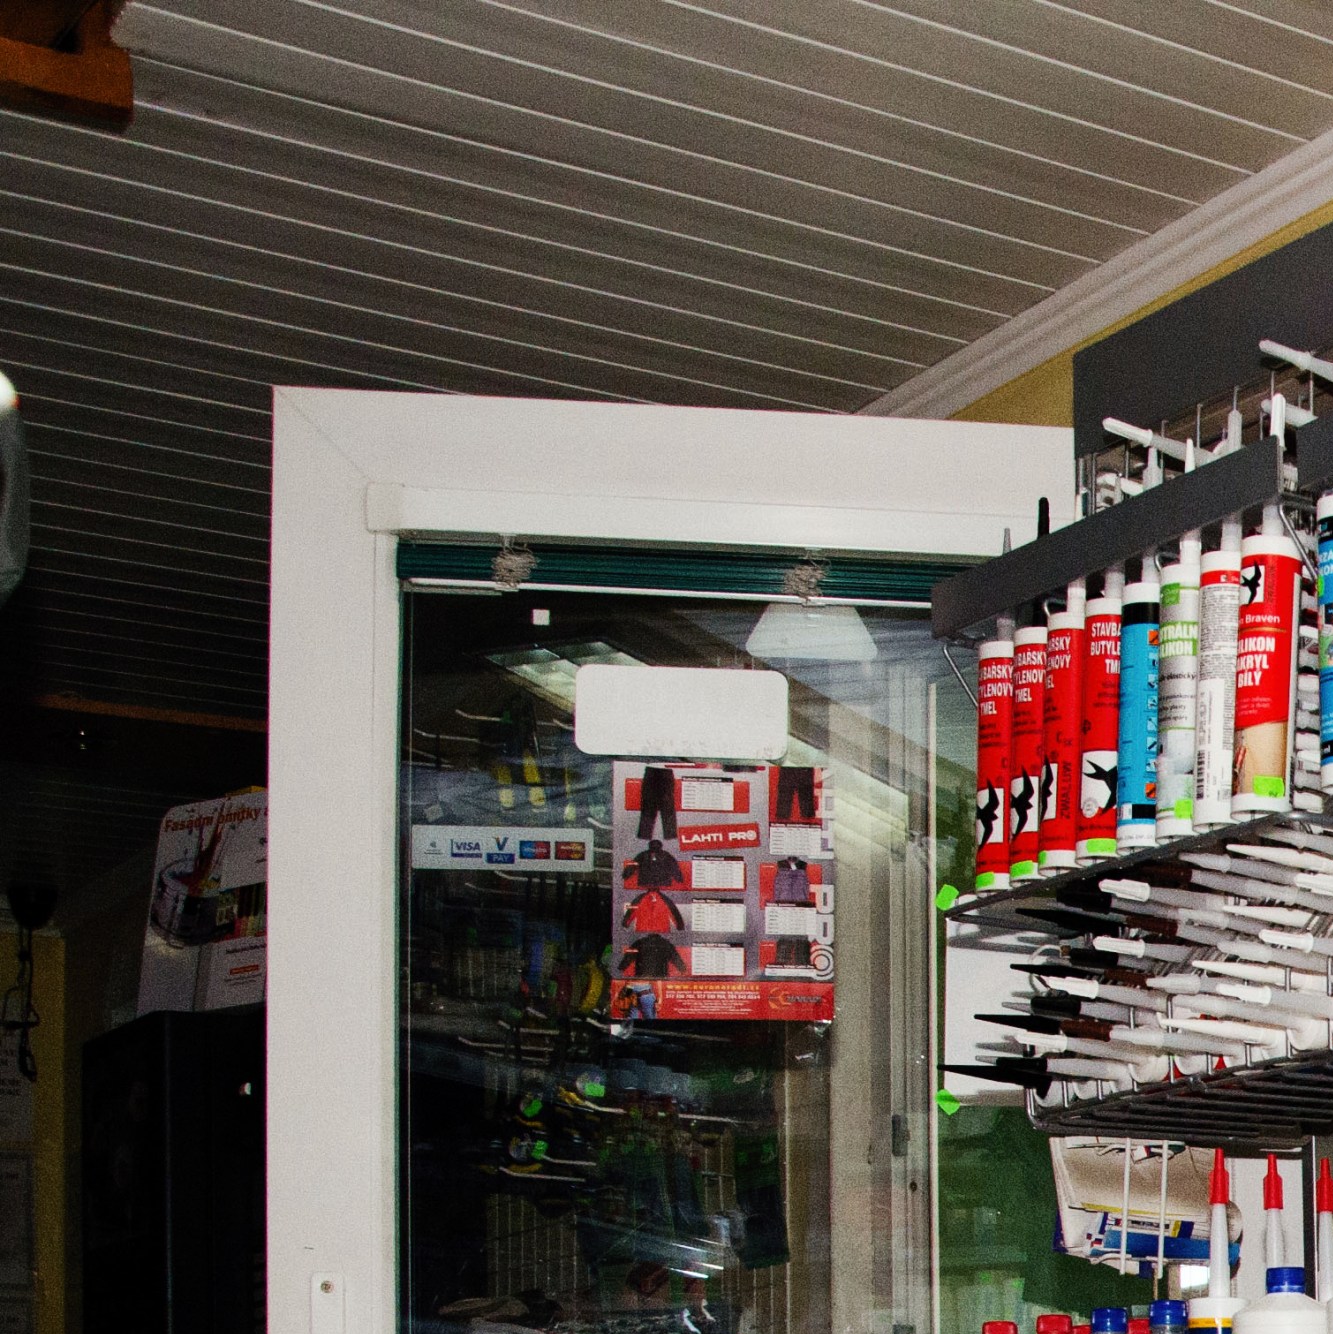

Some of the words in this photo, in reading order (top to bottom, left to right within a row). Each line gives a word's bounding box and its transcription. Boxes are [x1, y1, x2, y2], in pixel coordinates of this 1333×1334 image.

[1245, 613, 1281, 624] Braven
[681, 831, 723, 845] LAHTI
[728, 827, 757, 842] PRO
[455, 841, 481, 851] VISA
